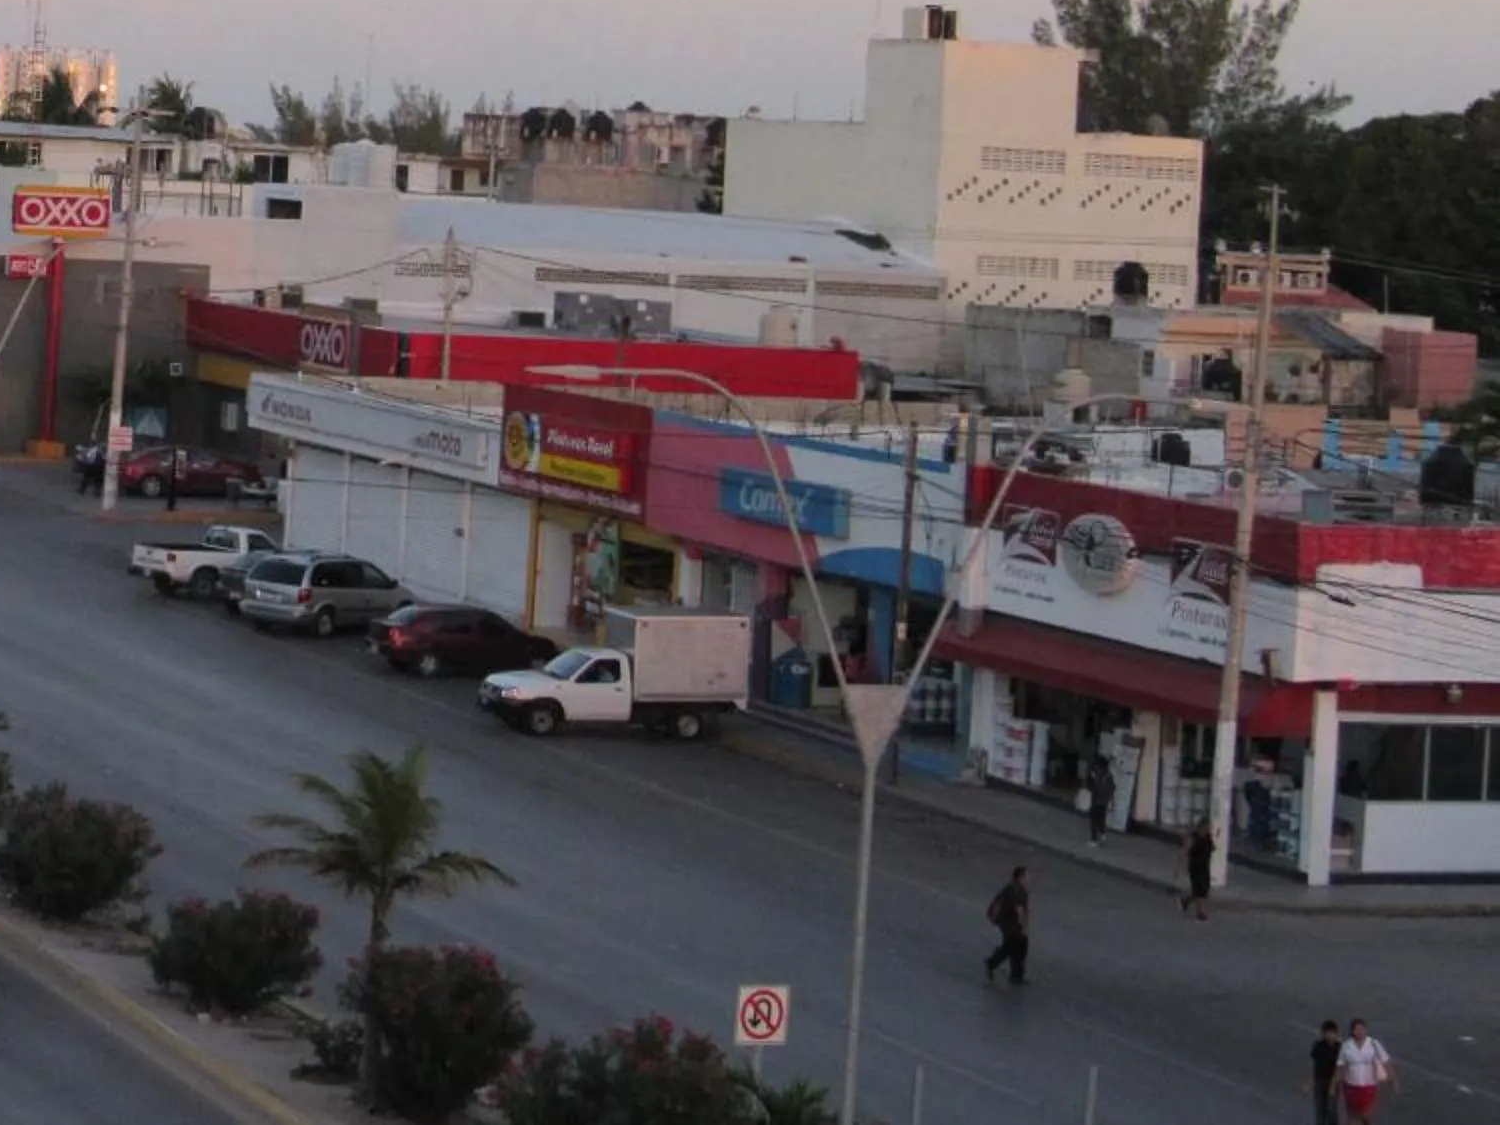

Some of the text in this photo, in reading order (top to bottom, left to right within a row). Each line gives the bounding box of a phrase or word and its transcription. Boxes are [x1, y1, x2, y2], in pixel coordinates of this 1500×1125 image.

[21, 197, 106, 227] OXXO
[301, 322, 345, 364] OXXO
[740, 479, 814, 525] Comx
